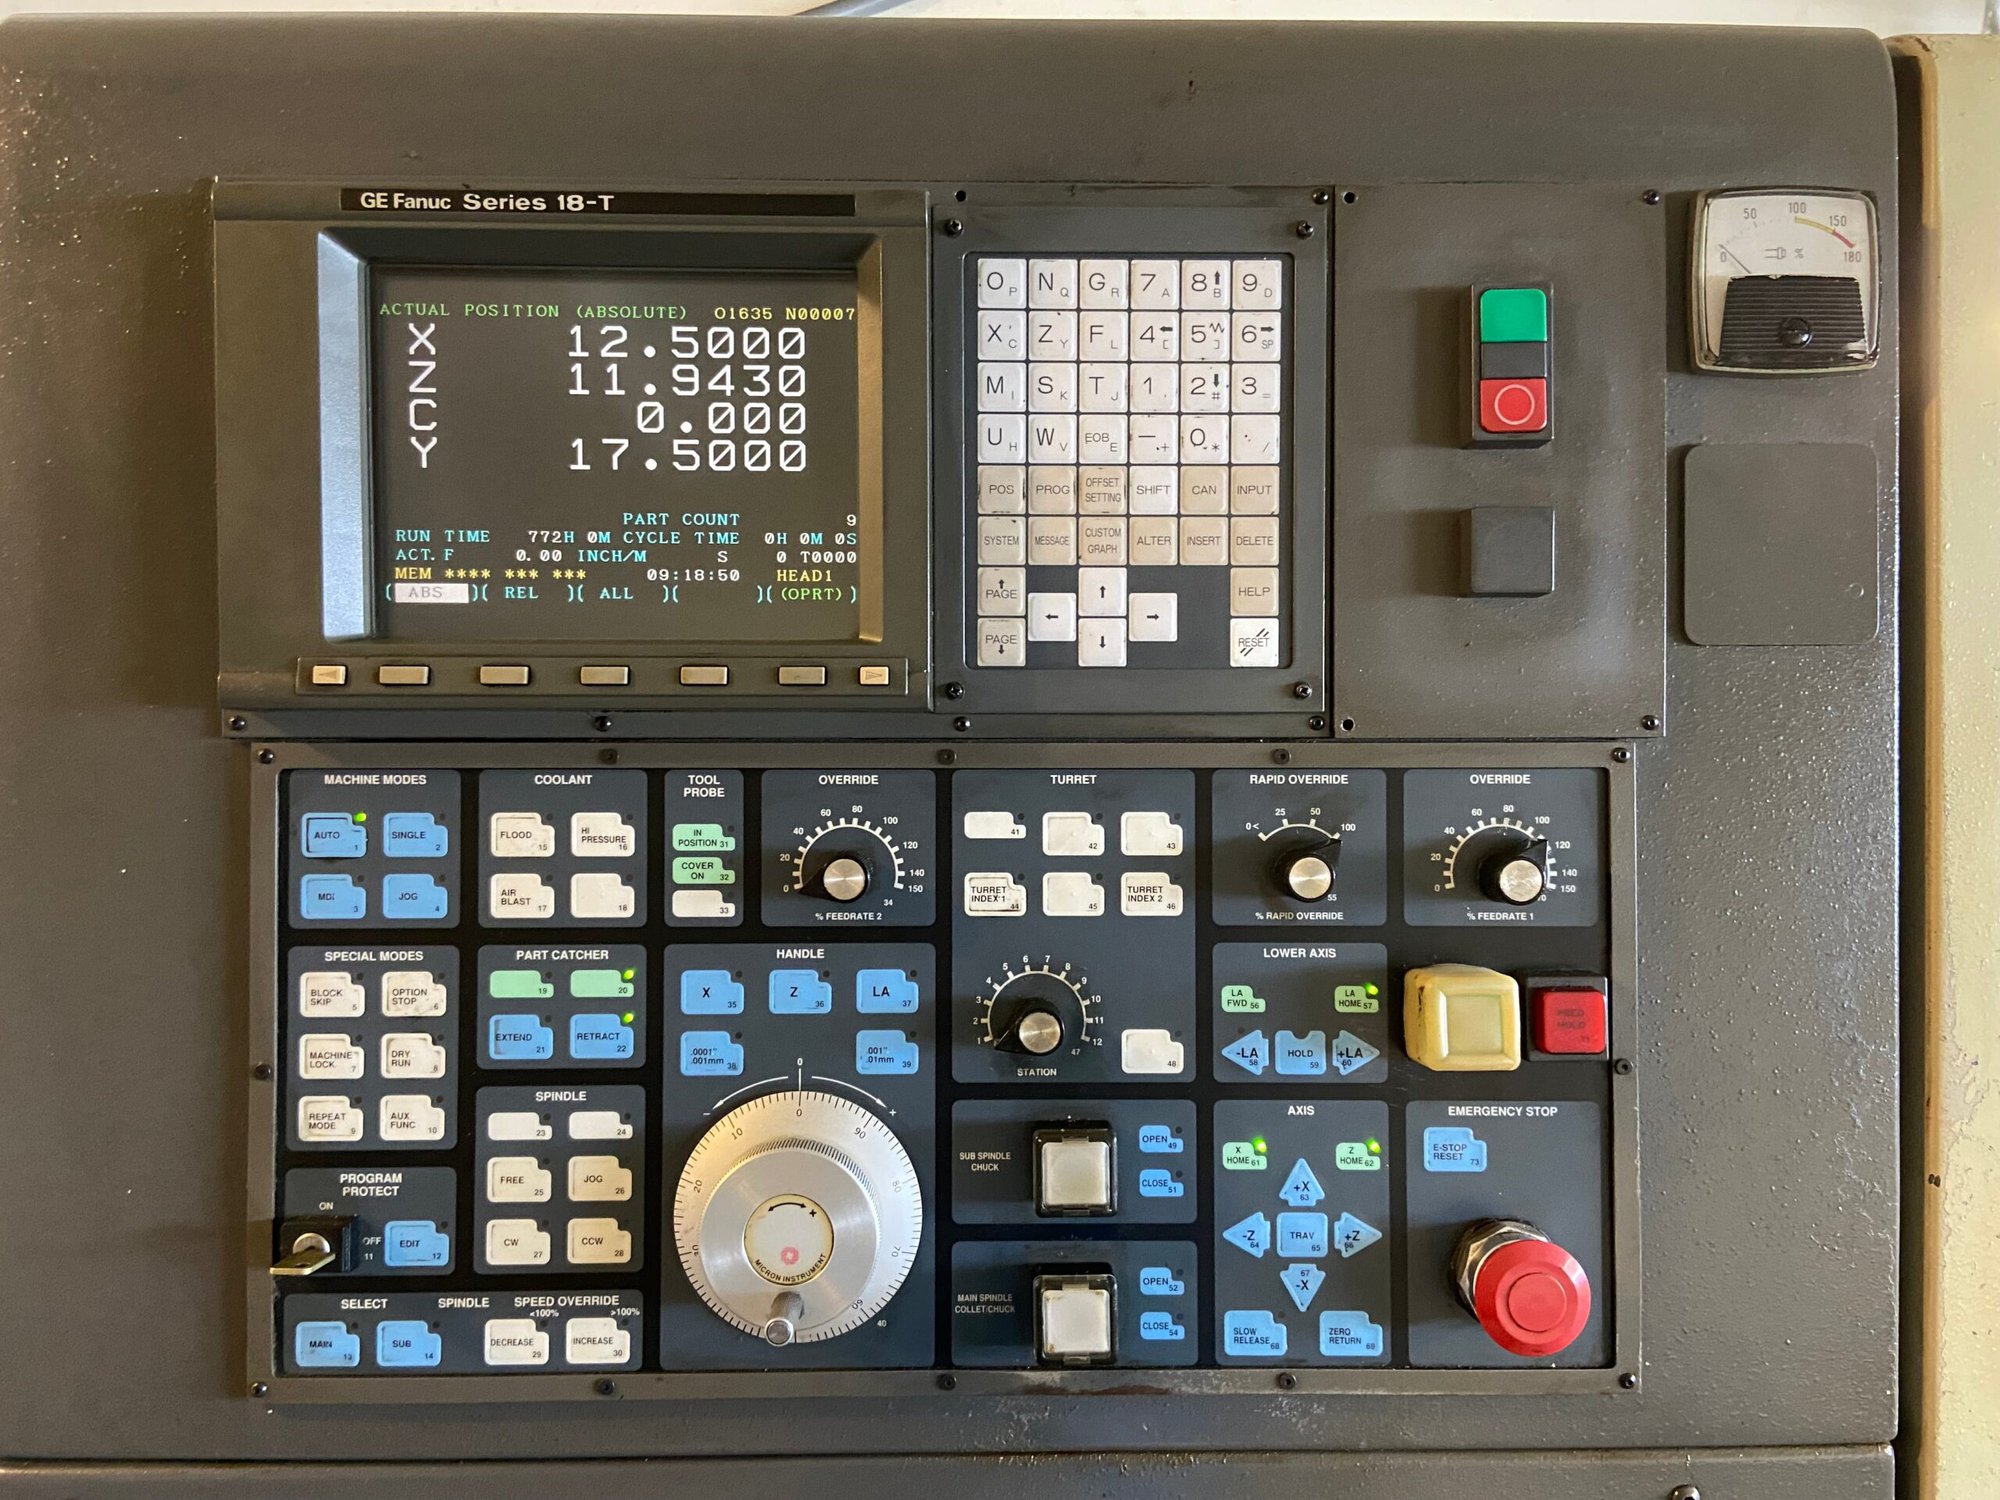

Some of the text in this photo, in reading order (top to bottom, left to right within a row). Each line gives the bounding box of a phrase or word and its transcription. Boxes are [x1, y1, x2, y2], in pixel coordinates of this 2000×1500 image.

[360, 192, 614, 211] GE Fanuc Series 18-T
[1789, 202, 1806, 213] 100
[1744, 208, 1757, 219] 50
[1829, 215, 1846, 226] 150
[1844, 251, 1861, 262] 180
[1039, 273, 1053, 290] N
[1089, 273, 1105, 290] G
[1141, 274, 1156, 291] 7
[1192, 274, 1207, 291] 8
[1242, 274, 1257, 291] 9
[380, 304, 688, 319] ACTUAL POSITION (ABSOLUTE)
[786, 308, 855, 321] N00007
[408, 323, 806, 358] X 12.5000
[408, 361, 806, 396] Z 11.9430
[409, 399, 806, 434] C 0.000
[1086, 433, 1109, 443] EOB
[410, 436, 806, 471] Y 17.5000
[1086, 478, 1119, 487] OFFSET
[989, 485, 1014, 494] POS
[1036, 485, 1070, 494] PROG
[1137, 485, 1171, 494] SHIFT
[1192, 486, 1216, 495] CAN
[1237, 485, 1272, 494] INPUT
[1085, 493, 1121, 503] SETTING
[623, 513, 740, 526] PART COUNT
[847, 514, 856, 527] 9
[1086, 528, 1121, 537] CUSTOM
[396, 530, 431, 543] RUN
[445, 530, 490, 543] TIME
[528, 531, 574, 544] 772H
[623, 531, 681, 545] CYCLE
[695, 532, 740, 545] TIME
[765, 532, 787, 545] 0H
[800, 532, 823, 546] 0M
[835, 533, 857, 546] 0S
[984, 536, 1019, 545] SYSTEM
[1035, 536, 1069, 546] MESSAGE
[1137, 536, 1171, 546] ALTER
[1187, 536, 1221, 546] INSERT
[1236, 536, 1273, 546] DELETE
[1088, 544, 1117, 554] GRAPH
[578, 550, 647, 563] INCH/M
[801, 551, 856, 564] T0000
[395, 568, 432, 580] MEM
[647, 569, 740, 582] 09:18:50
[777, 569, 832, 582] HEAD1
[409, 587, 442, 599] ABS
[504, 587, 538, 599] REL
[600, 587, 634, 600] ALL
[781, 588, 842, 602] (OPRT)
[986, 589, 1017, 599] PAGE
[1239, 587, 1270, 596] HELP
[986, 635, 1016, 644] PAGE
[1239, 638, 1269, 647] RESET
[325, 775, 426, 785] MACHINE MODES
[535, 775, 592, 784] COOLANT
[688, 775, 720, 784] TOOL
[819, 775, 879, 785] OVERRIDE
[1050, 775, 1097, 784] TURRET
[1250, 775, 1348, 784] RAPID OVERRIDE
[1470, 775, 1531, 784] OVERRIDE
[684, 787, 725, 797] PROBE
[392, 831, 425, 839] SINGLE
[501, 831, 532, 839] FLOOD
[678, 839, 717, 847] POSITION
[691, 872, 704, 880] ON
[325, 951, 423, 961] SPECIAL MODES
[517, 950, 609, 960] PART CATCHER
[776, 949, 824, 958] HANDLE
[1264, 948, 1336, 958] LOWER AXIS
[311, 989, 342, 997] BLOCK
[873, 986, 890, 997] LA
[311, 998, 331, 1006] SKIP
[392, 997, 416, 1005] STOP
[310, 1061, 335, 1069] LOCK
[1017, 1068, 1057, 1076] STATION
[536, 1091, 587, 1101] SPINDLE
[1287, 1106, 1314, 1115] AXIS
[1448, 1106, 1558, 1116] EMERGENCY STOP
[309, 1113, 345, 1121] REPEAT
[309, 1122, 336, 1130] MODE
[1142, 1135, 1167, 1143] OPEN
[959, 1152, 1011, 1160] SUB SPINDLE
[971, 1163, 999, 1171] CHUCK
[340, 1174, 402, 1183] PROGRAM
[500, 1176, 524, 1184] FREE
[1142, 1179, 1168, 1187] CLOSE
[343, 1186, 399, 1196] PROTECT
[400, 1240, 420, 1248] EDIT
[755, 1254, 826, 1282] MICRON INSTRUMENT
[341, 1299, 388, 1309] SELECT
[438, 1298, 490, 1308] SPINDLE
[514, 1296, 619, 1307] SPEED OVERRIDE
[490, 1338, 534, 1347] DECREASE
[572, 1336, 614, 1345] INCREASE
